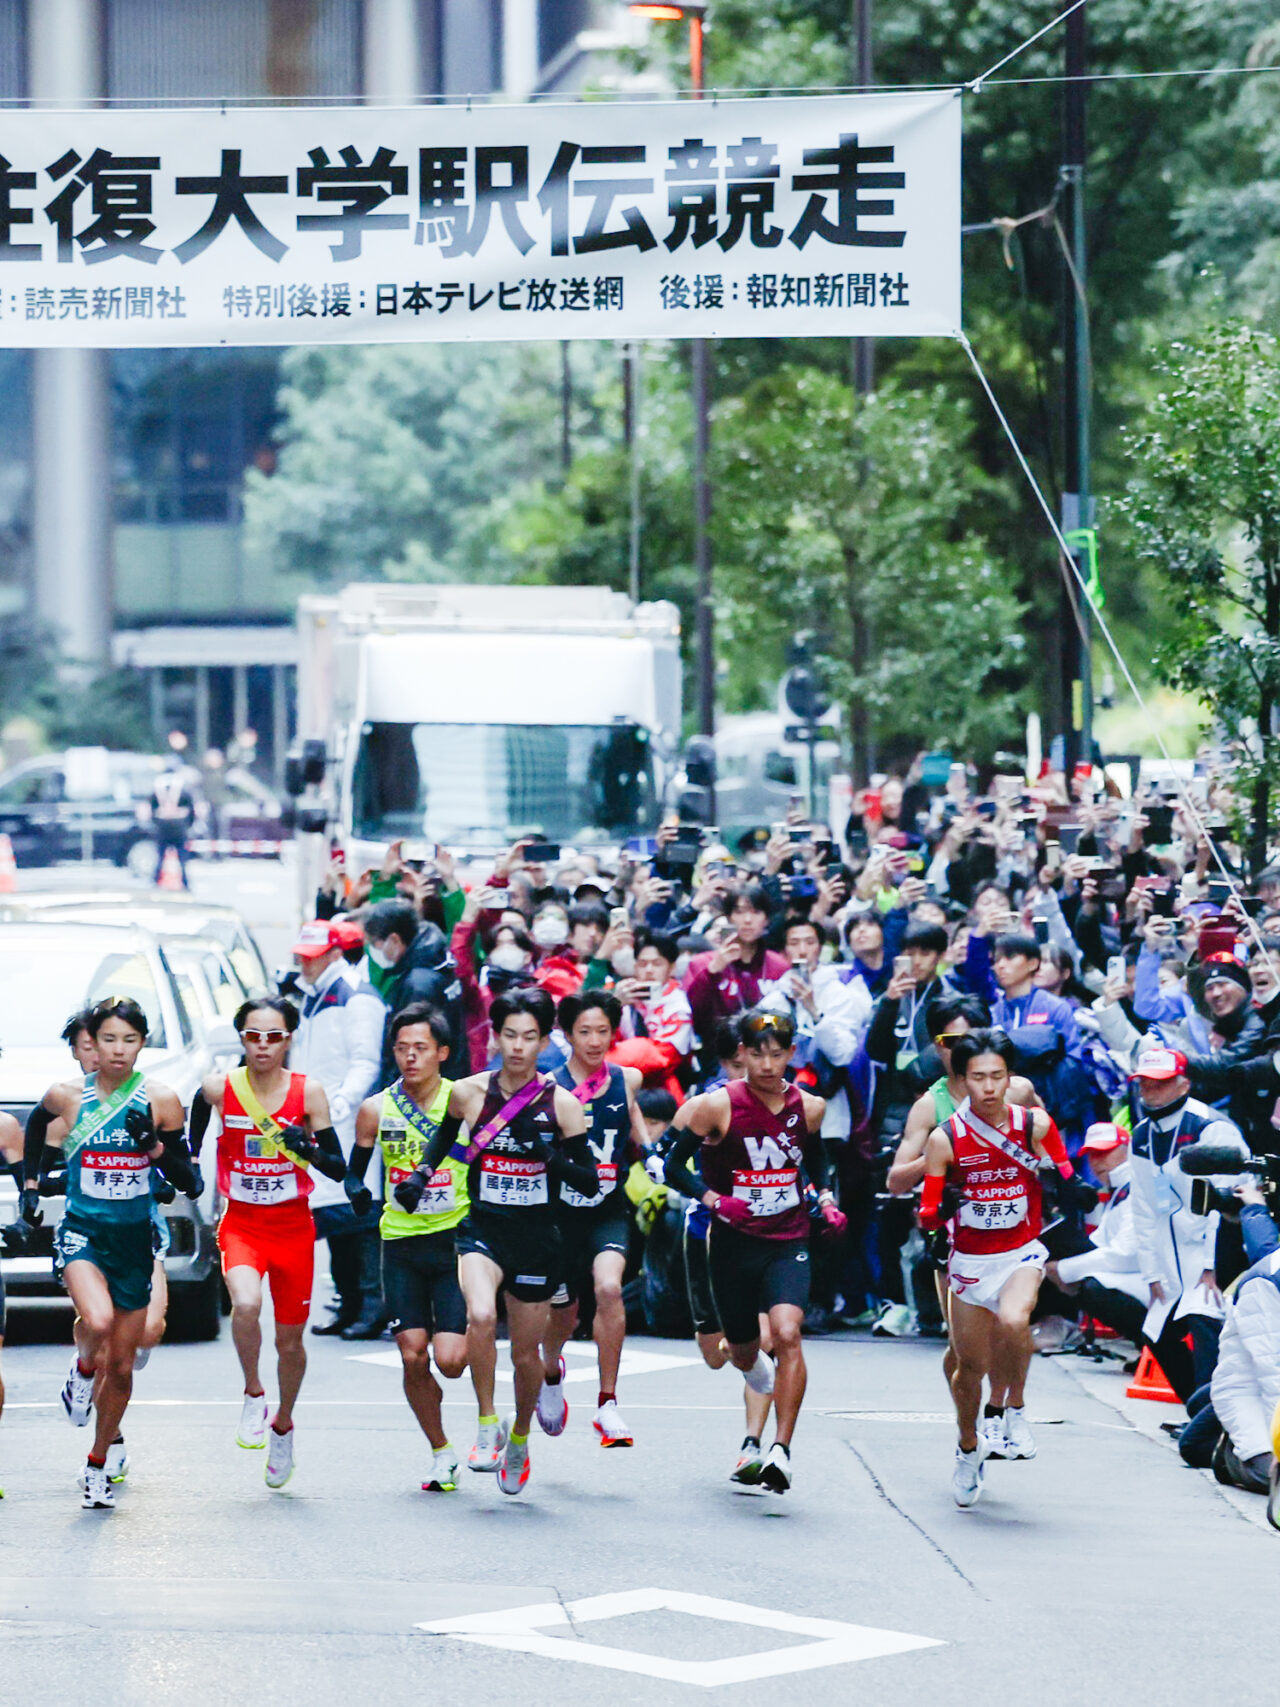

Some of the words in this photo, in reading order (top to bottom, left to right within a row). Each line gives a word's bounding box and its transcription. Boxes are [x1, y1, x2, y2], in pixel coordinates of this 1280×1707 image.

[223, 276, 625, 318] 特別後援：日本テレビ放送網
[660, 272, 910, 310] 後援：報知新聞社
[97, 1155, 149, 1168] SAPPORO
[243, 1162, 295, 1174] SAPPORO
[496, 1162, 547, 1175] SAPPORO
[93, 1170, 140, 1186] 青学大
[486, 1175, 542, 1193] 國學院大
[748, 1189, 789, 1203] 早大
[976, 1183, 1024, 1199] SAPPORO
[971, 1202, 1019, 1218] 帝京大
